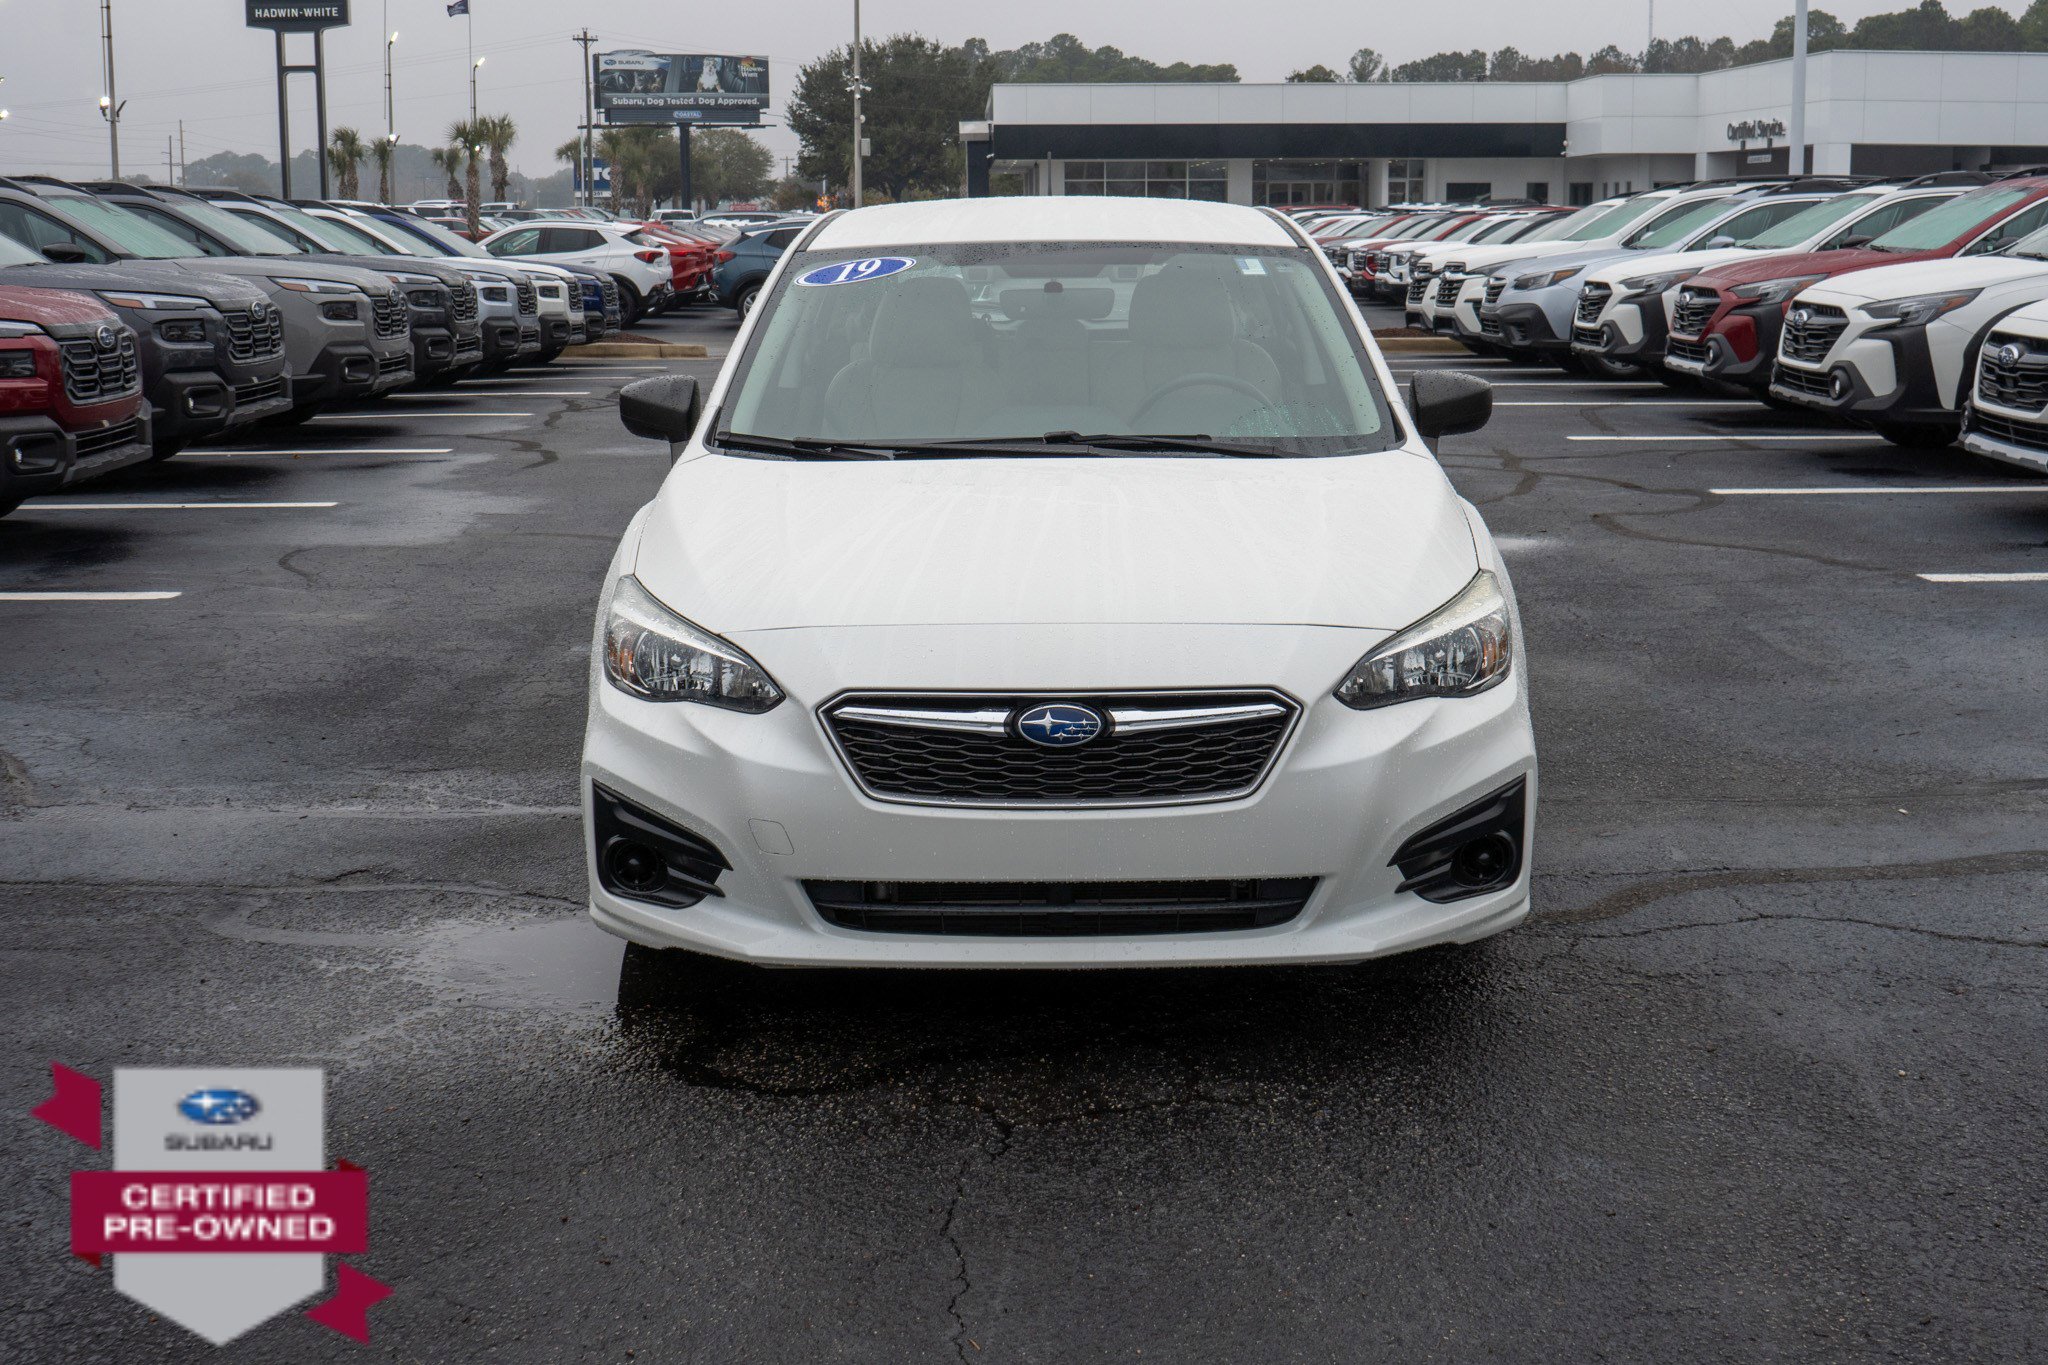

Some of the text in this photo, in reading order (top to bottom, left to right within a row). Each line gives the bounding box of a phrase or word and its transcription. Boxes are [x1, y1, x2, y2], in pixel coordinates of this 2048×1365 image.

[254, 7, 339, 18] HADWIN-WHITE
[612, 97, 760, 107] Subaru, Dog Tested. Dog Approved.
[1727, 120, 1756, 140] Certified
[830, 258, 882, 285] 19
